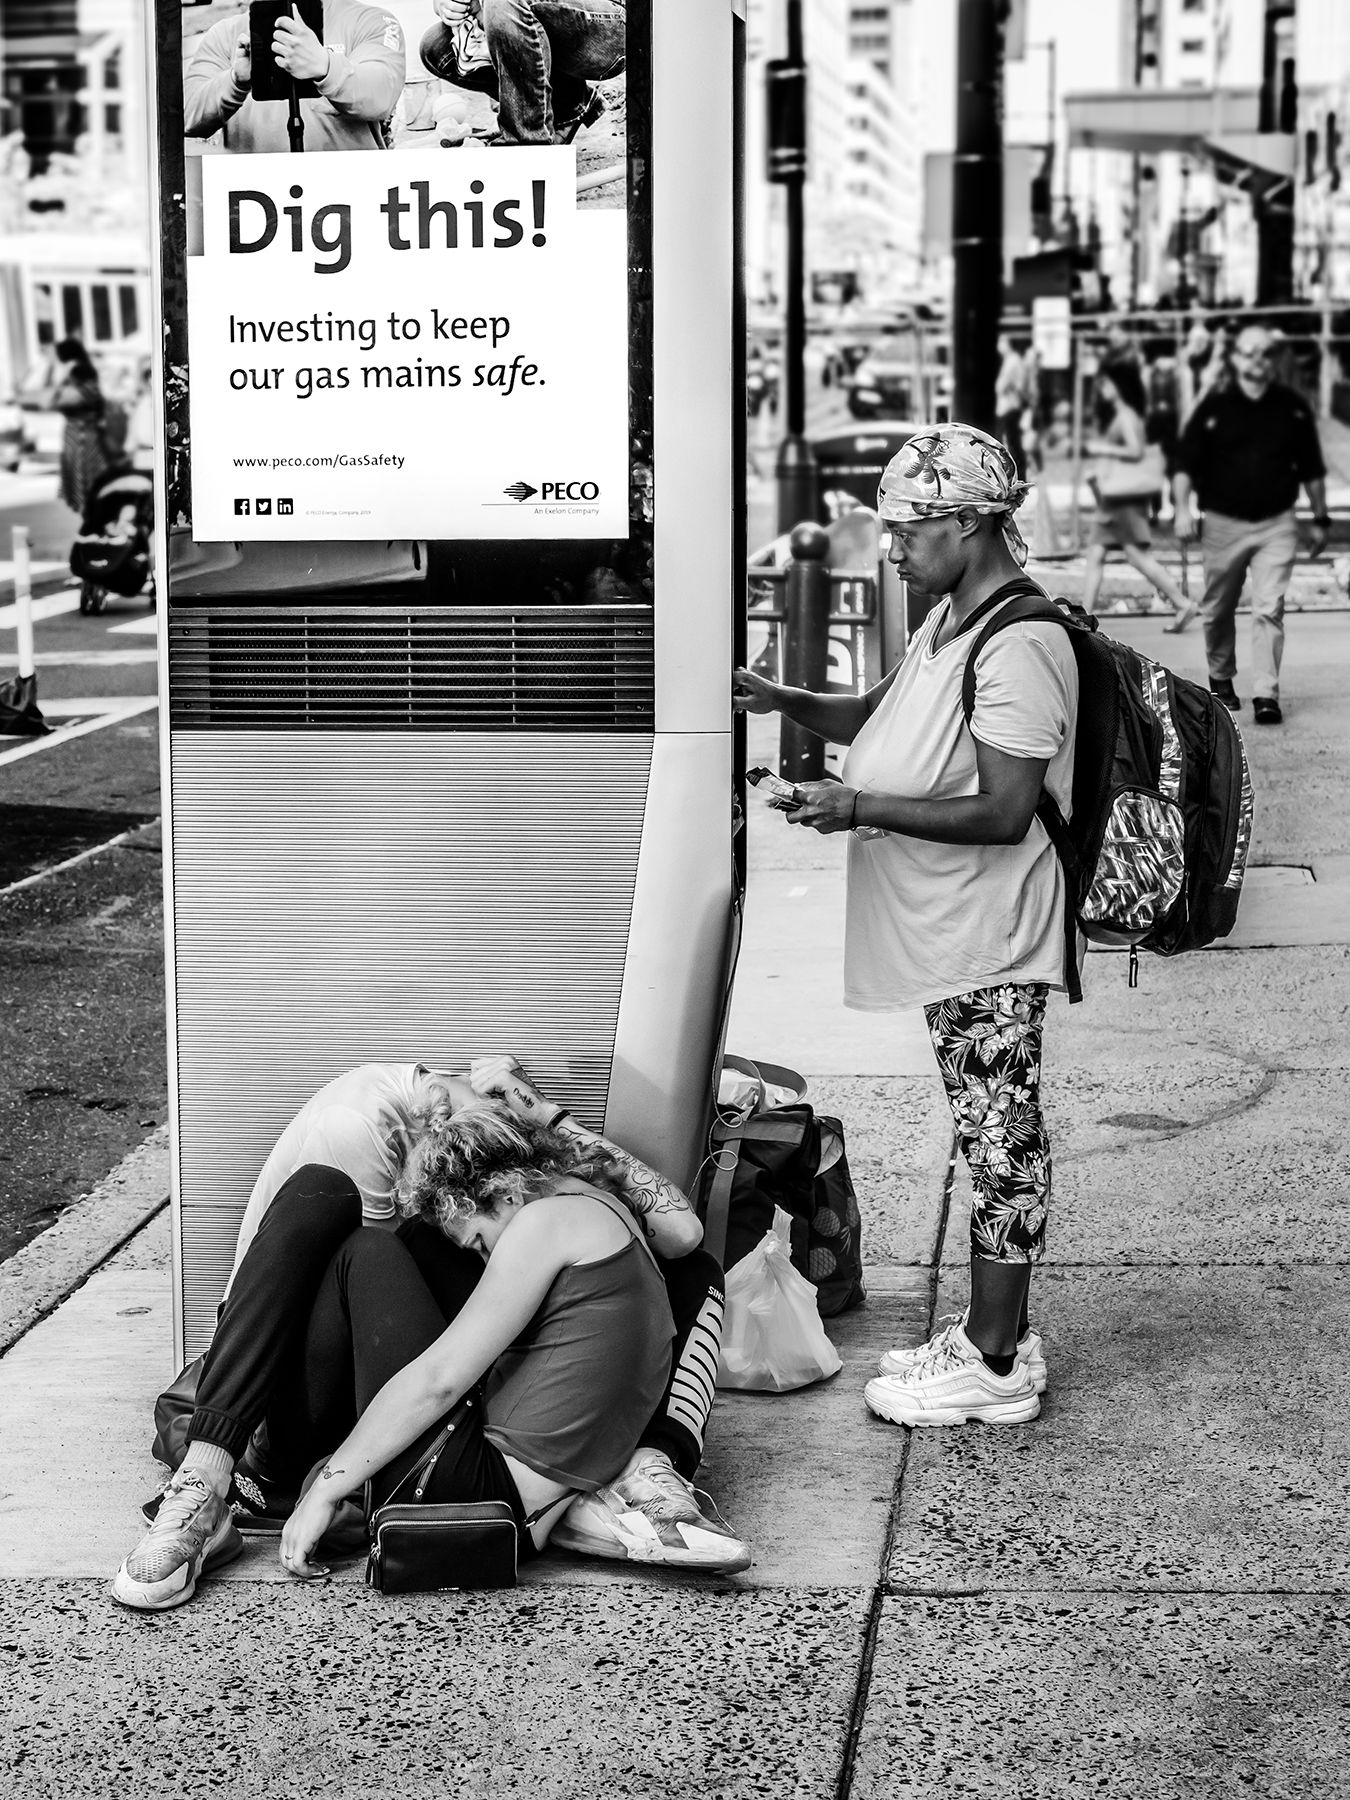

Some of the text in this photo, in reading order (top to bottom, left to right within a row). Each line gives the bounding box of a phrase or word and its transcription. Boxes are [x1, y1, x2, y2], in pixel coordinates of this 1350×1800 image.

[229, 180, 547, 274] Dig this!
[229, 309, 510, 351] Investing to keep
[229, 355, 546, 399] our gas mains safe.
[232, 454, 405, 470] www.peco.com/GasSafety
[541, 481, 600, 501] PECO
[533, 508, 544, 516] An
[567, 507, 600, 517] Company
